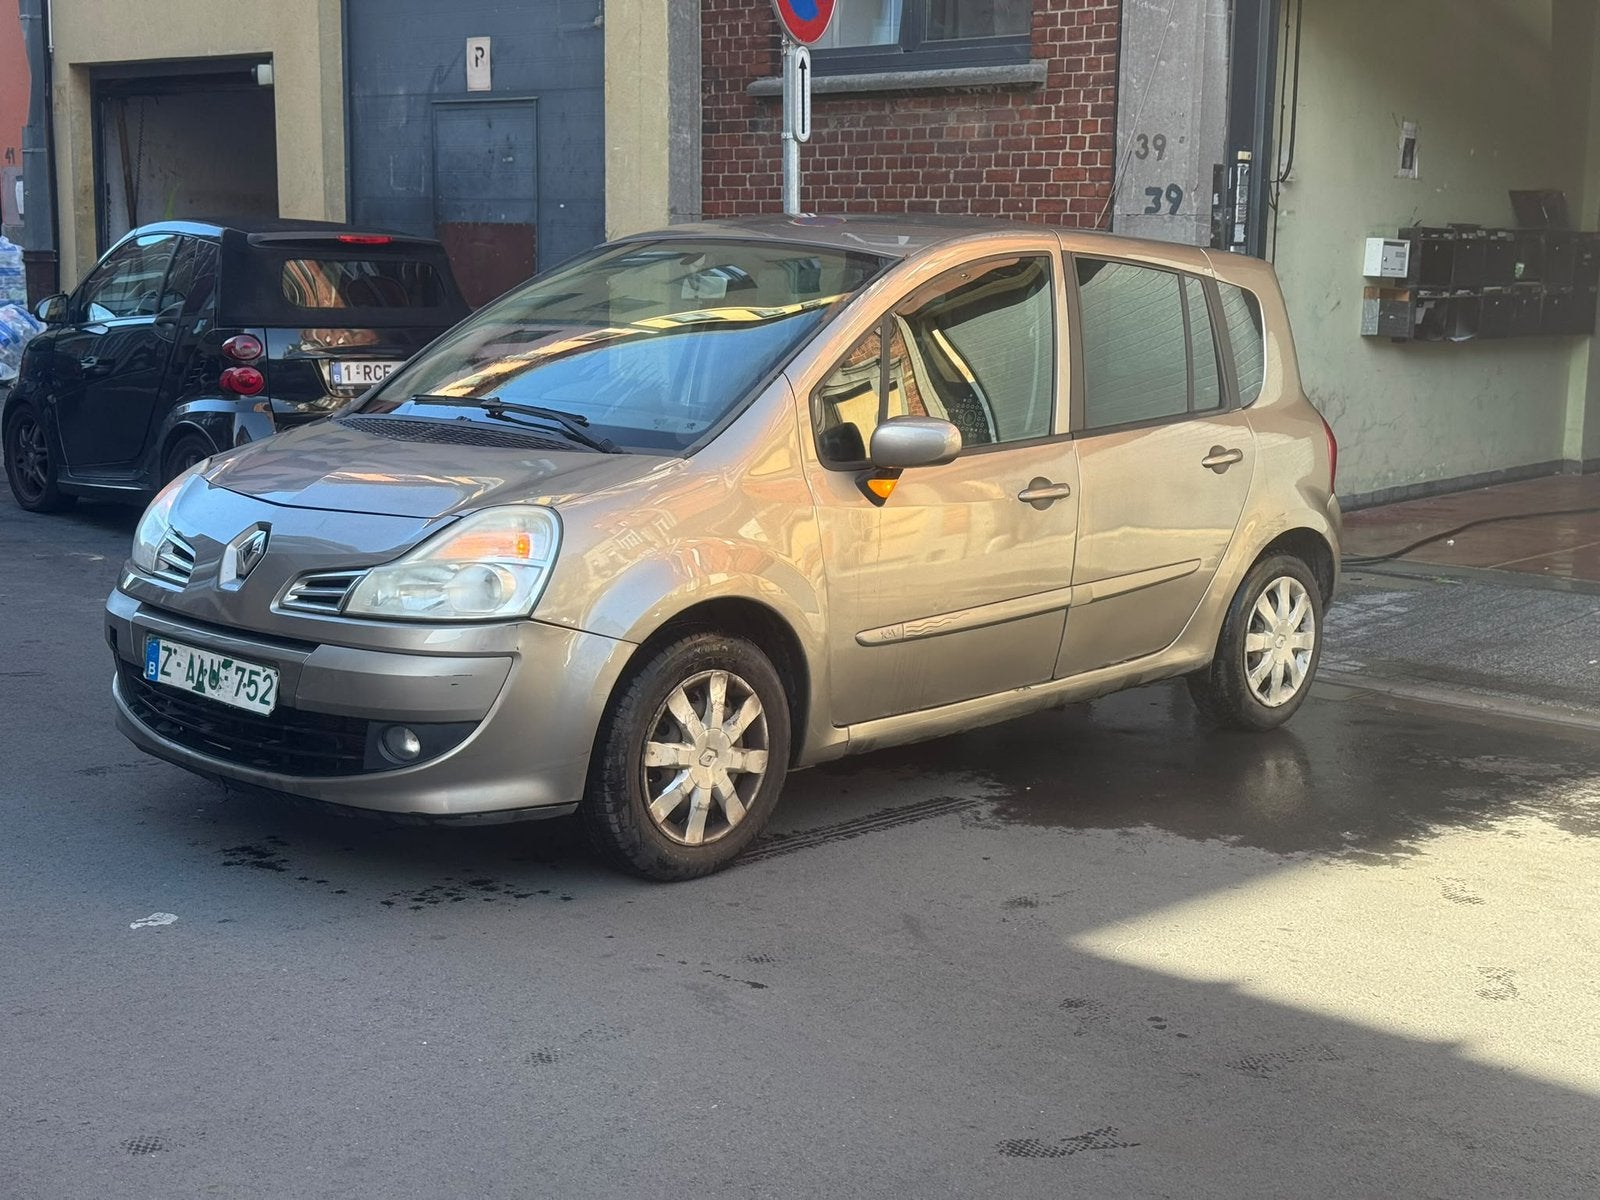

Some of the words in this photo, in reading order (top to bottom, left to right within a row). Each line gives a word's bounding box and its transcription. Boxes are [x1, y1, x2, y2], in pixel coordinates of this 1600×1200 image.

[1135, 133, 1167, 161] 39
[1144, 183, 1183, 215] 39
[148, 661, 156, 675] B
